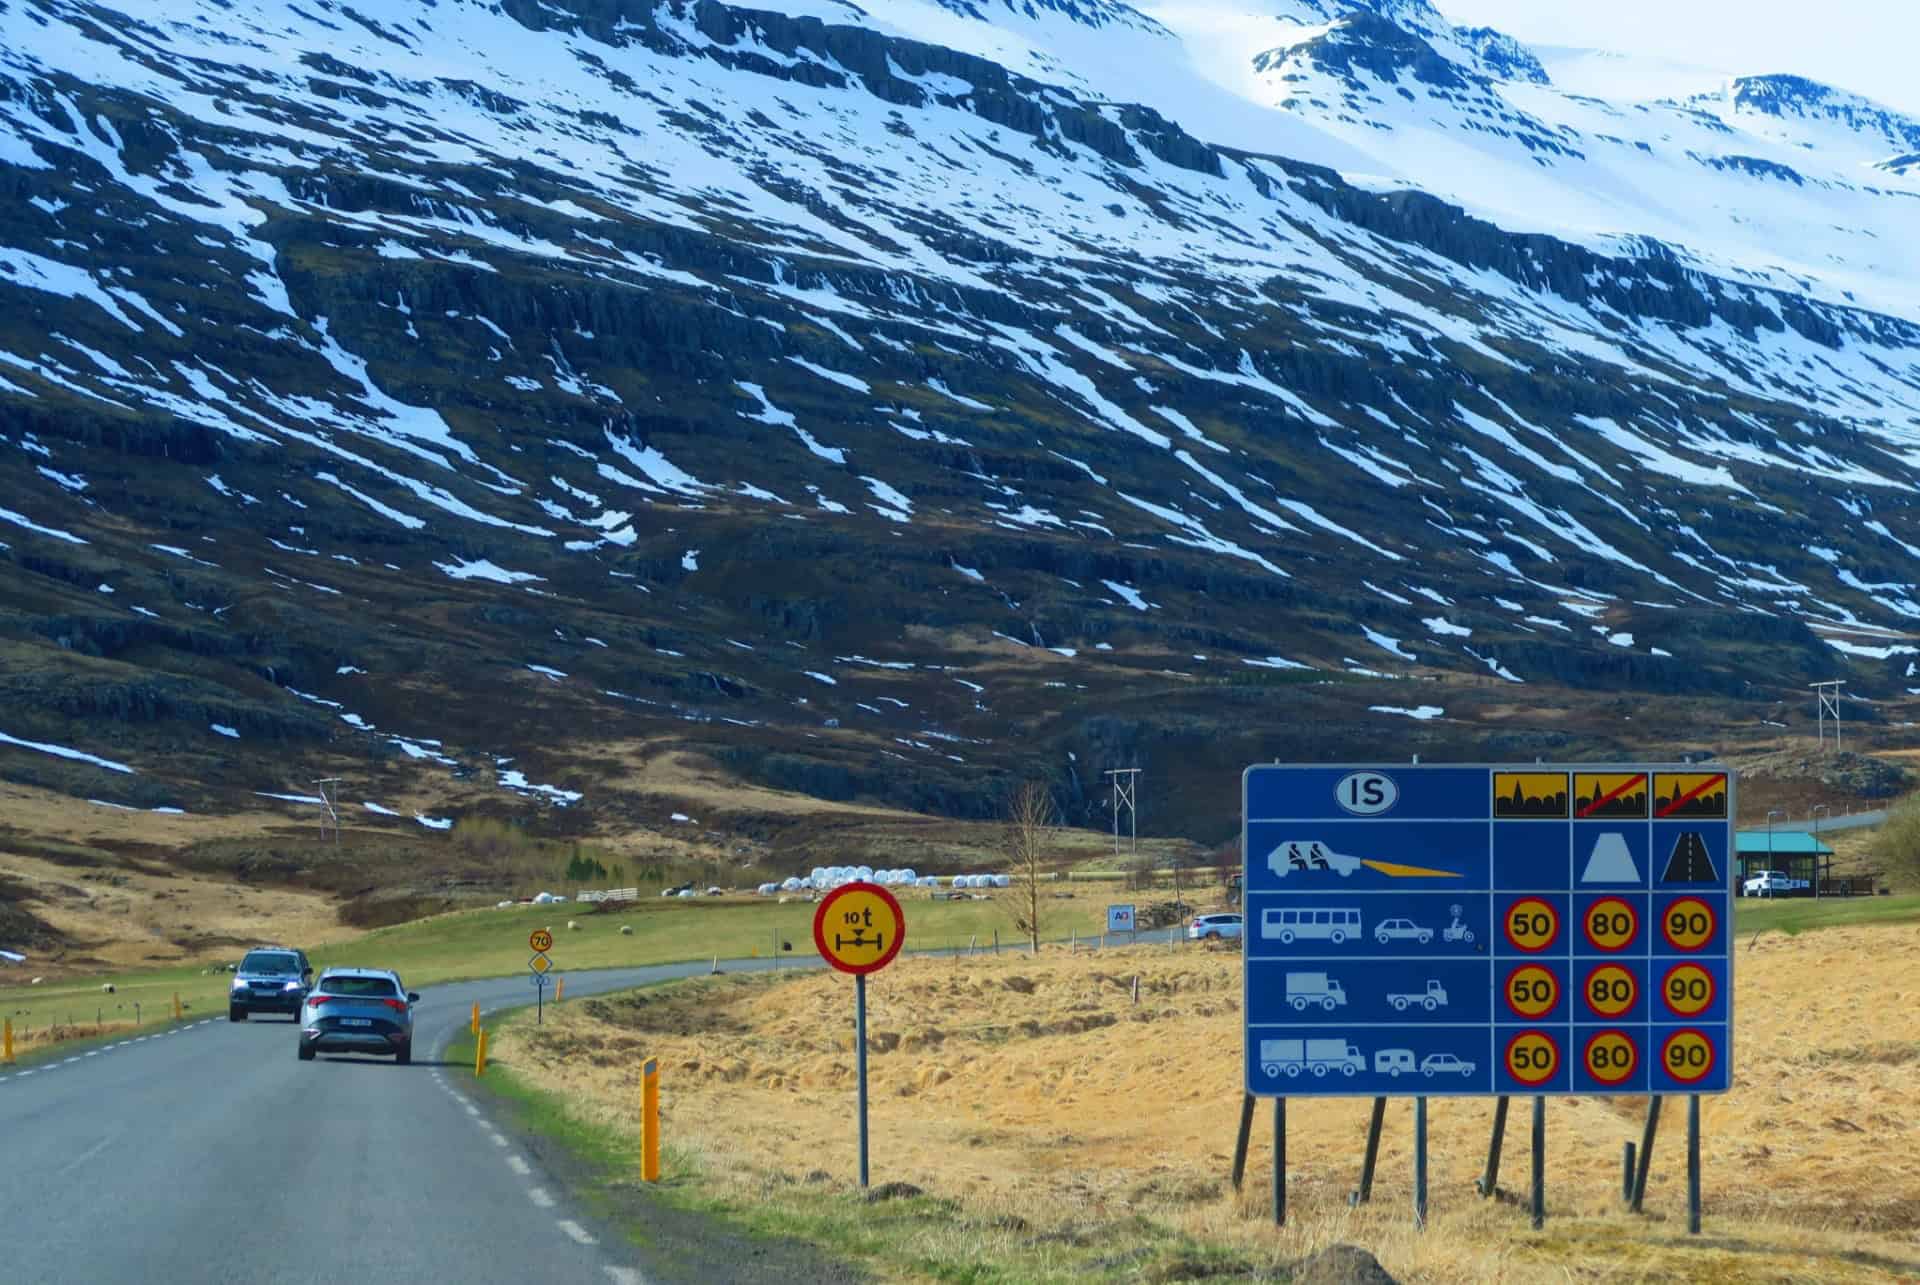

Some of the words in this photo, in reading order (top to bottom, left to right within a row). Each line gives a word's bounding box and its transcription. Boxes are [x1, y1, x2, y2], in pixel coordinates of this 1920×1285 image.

[1351, 778, 1384, 805] IS
[1514, 914, 1550, 936] 50
[1593, 914, 1629, 935] 80
[1670, 912, 1706, 935] 90
[535, 936, 549, 946] 70
[1514, 980, 1550, 1002] 50
[1593, 980, 1629, 1001] 80
[1671, 979, 1706, 1000] 90
[1515, 1047, 1550, 1068] 50
[1592, 1046, 1629, 1068] 80
[1670, 1045, 1706, 1066] 90
